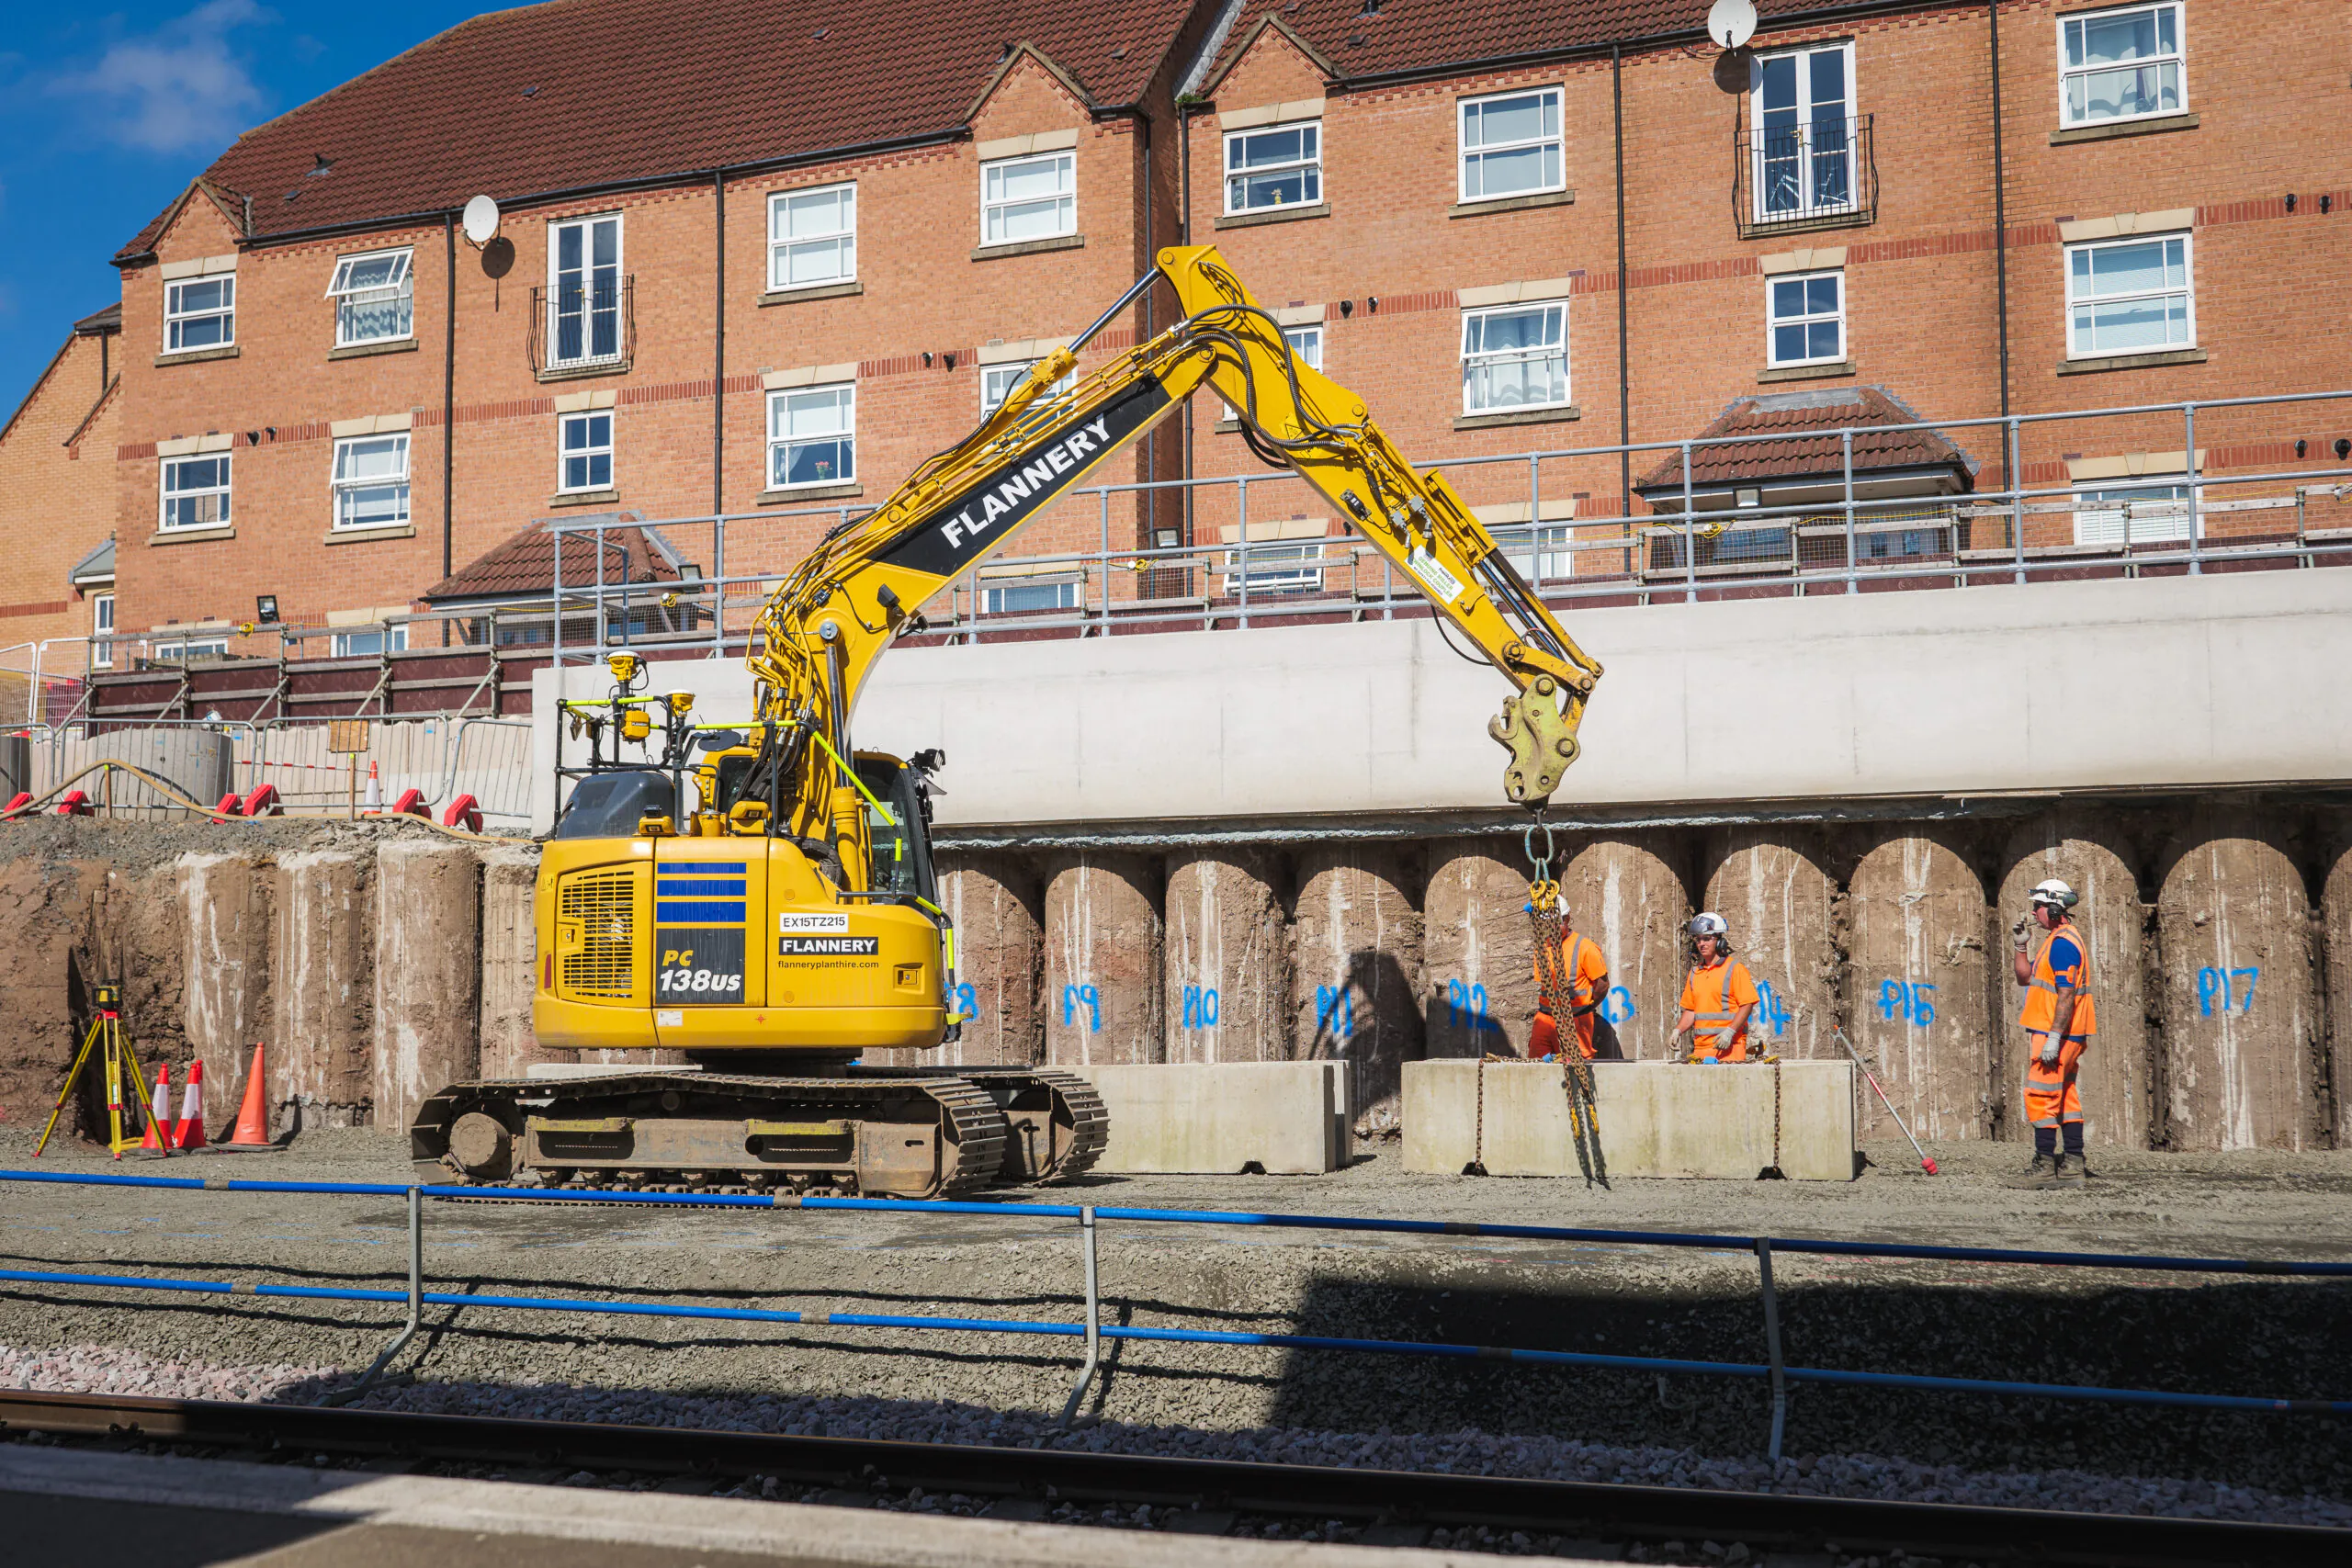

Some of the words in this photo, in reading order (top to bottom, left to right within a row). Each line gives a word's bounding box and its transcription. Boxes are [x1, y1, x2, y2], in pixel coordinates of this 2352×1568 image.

[940, 412, 1111, 549] FLANNERY
[783, 916, 845, 928] EX15TZ215
[662, 949, 694, 966] PC
[778, 960, 879, 970] flanneryplanthire.com
[782, 940, 876, 953] FLANNERY
[1063, 984, 1102, 1033] P9
[1182, 986, 1219, 1030] P10
[1449, 977, 1499, 1032] P12
[1601, 986, 1635, 1024] 13
[1748, 979, 1791, 1035] 14
[2198, 966, 2259, 1017] P17
